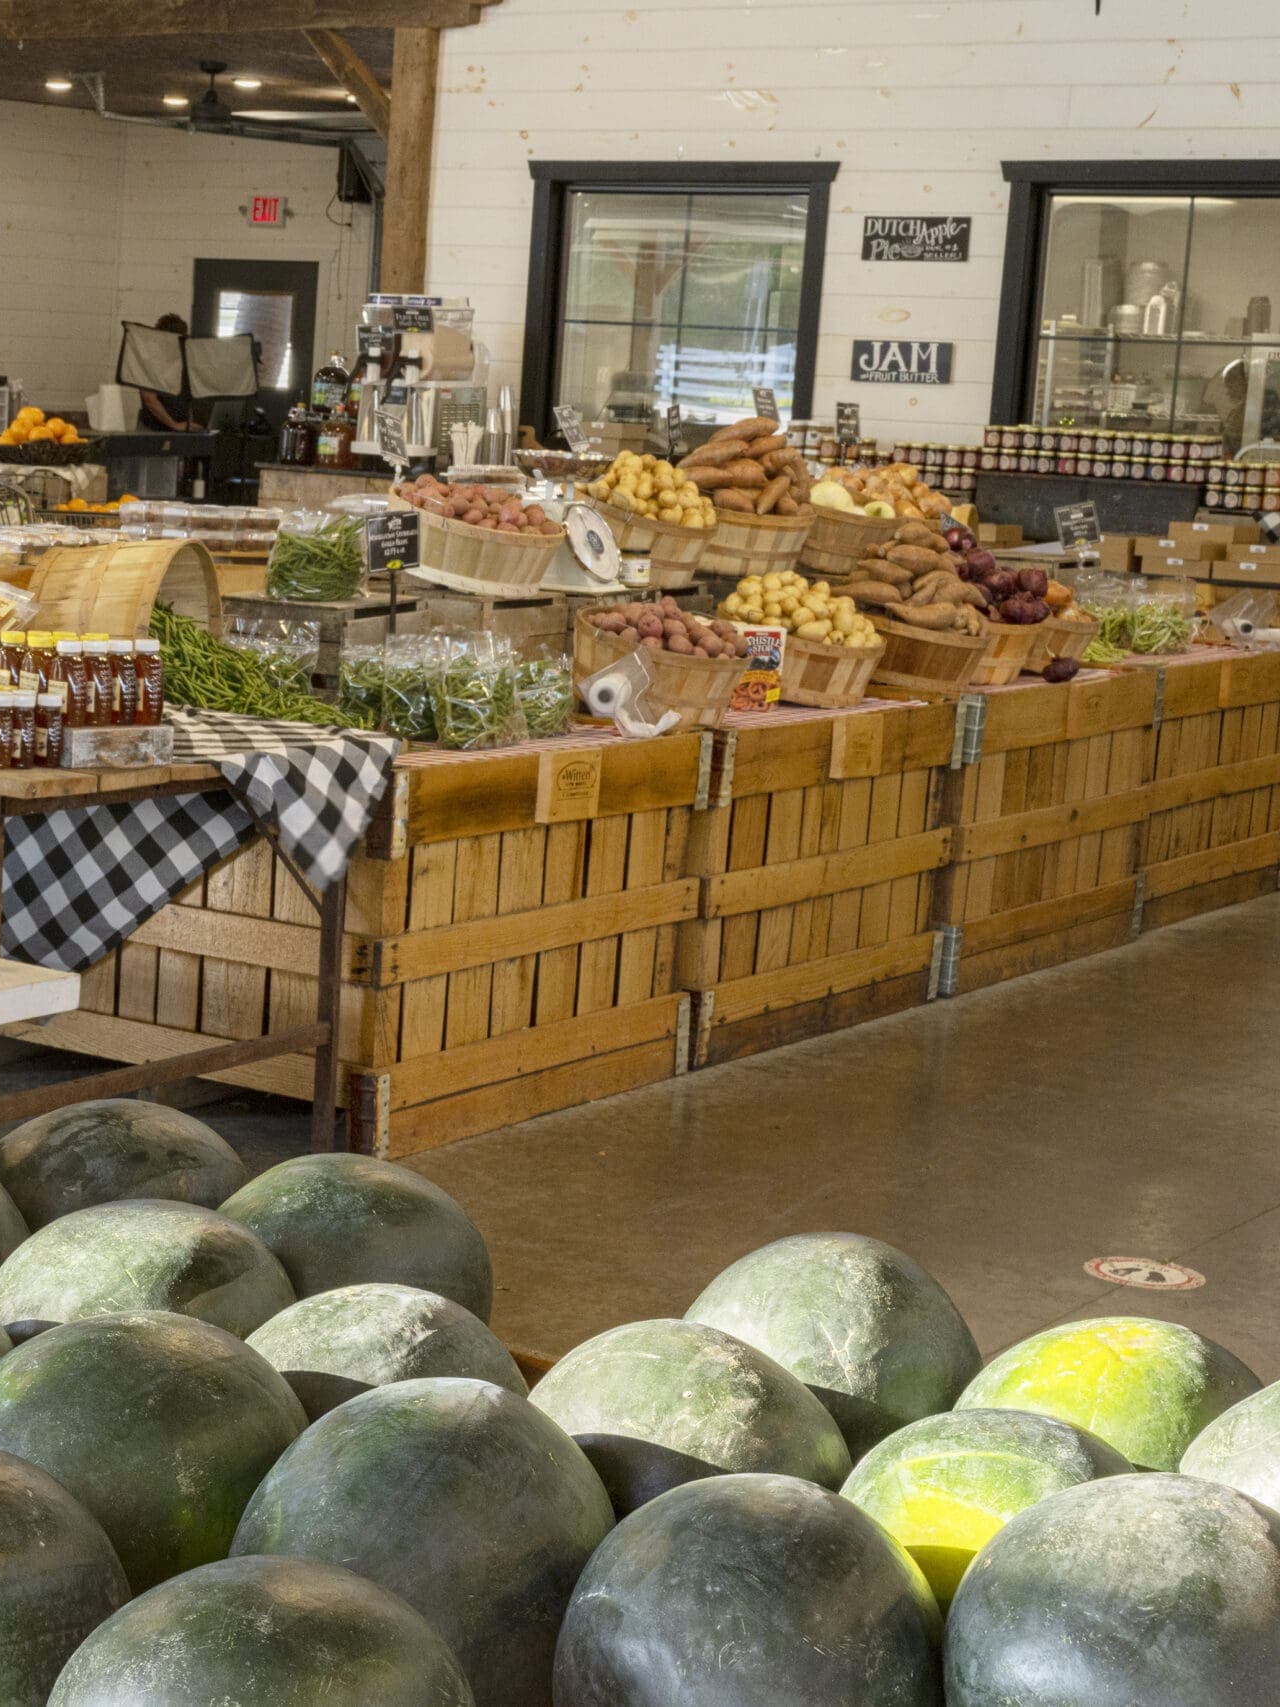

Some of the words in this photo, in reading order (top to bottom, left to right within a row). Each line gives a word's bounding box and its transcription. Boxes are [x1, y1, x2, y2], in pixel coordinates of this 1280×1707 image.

[253, 197, 279, 223] EXIT
[865, 218, 920, 236] DUTCH
[913, 217, 967, 245] Apple
[859, 341, 939, 373] JAM
[869, 371, 898, 381] FRUIT
[899, 371, 940, 383] BUTTER
